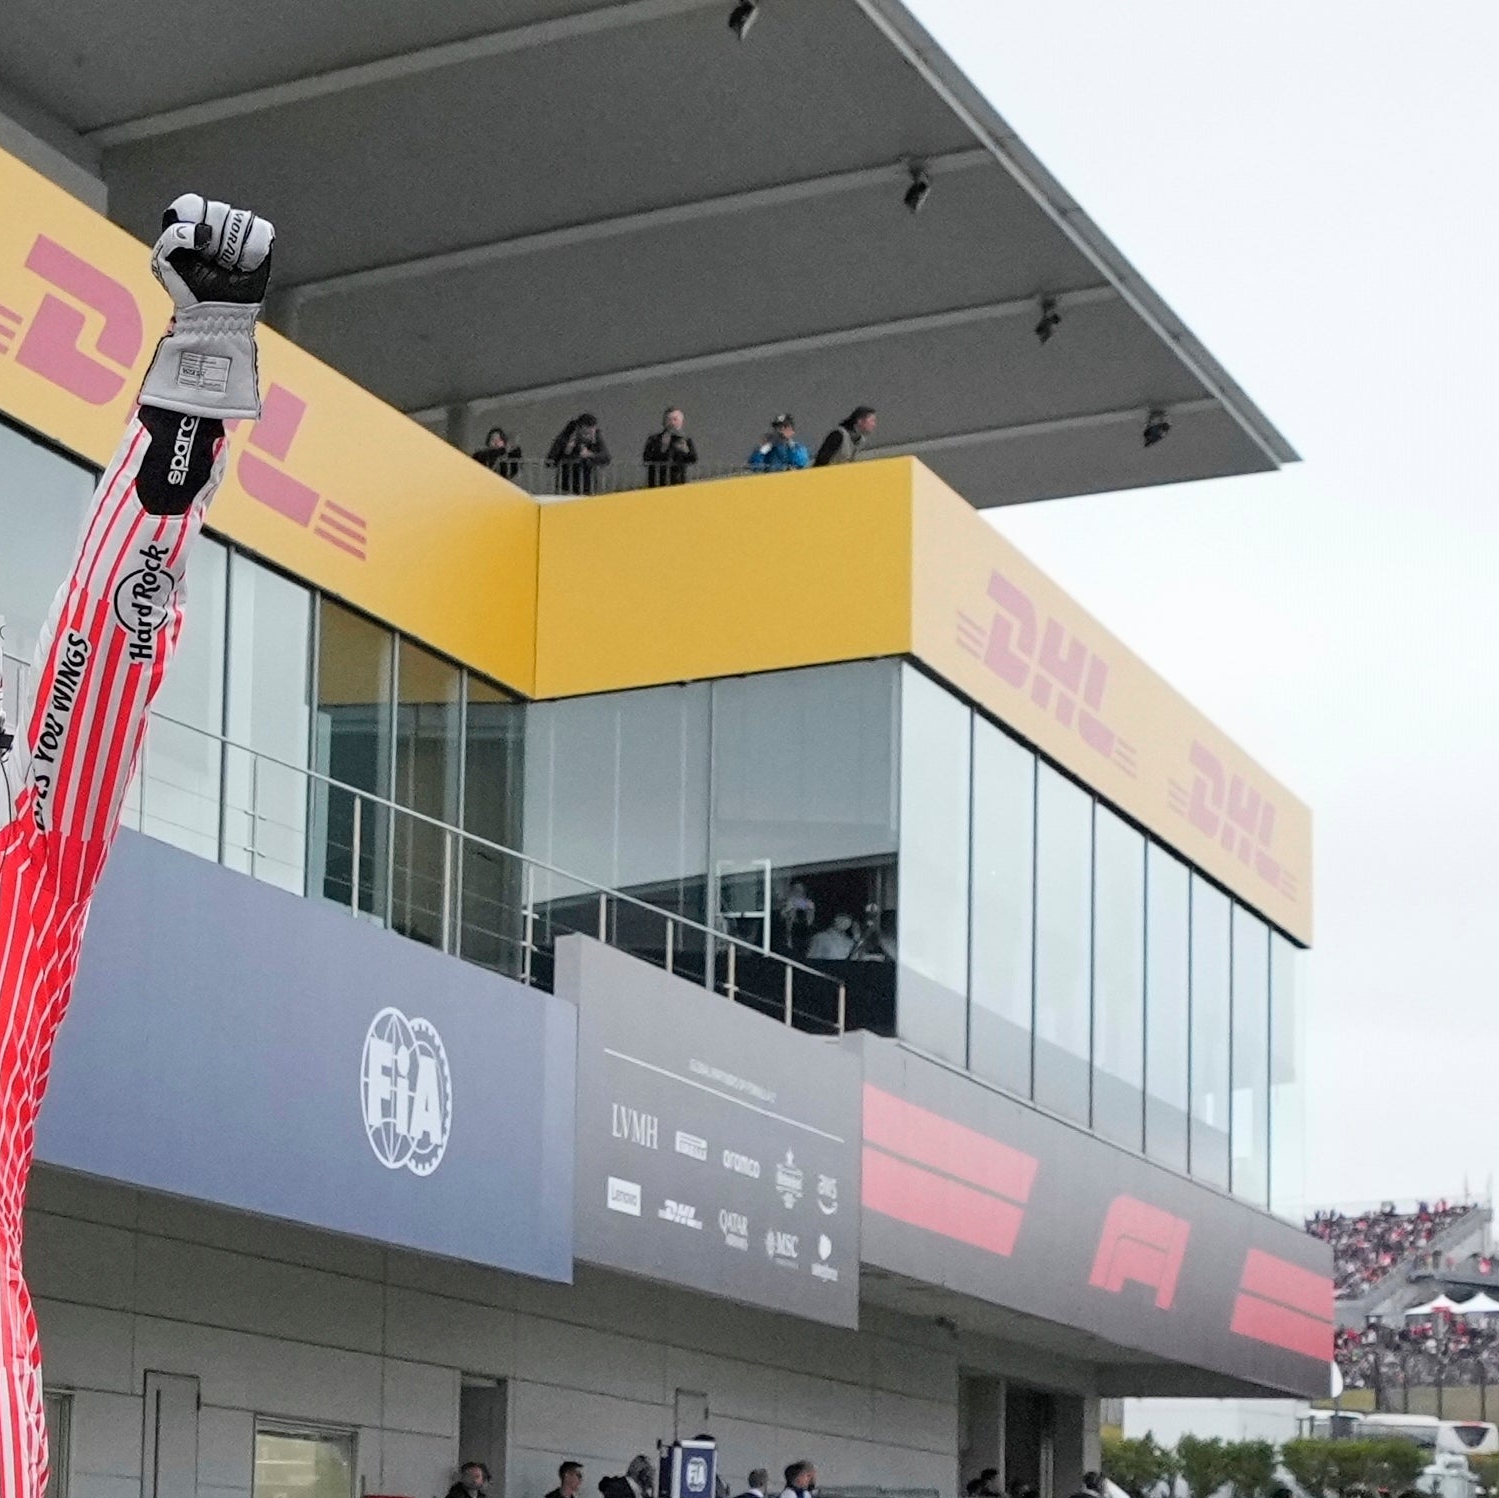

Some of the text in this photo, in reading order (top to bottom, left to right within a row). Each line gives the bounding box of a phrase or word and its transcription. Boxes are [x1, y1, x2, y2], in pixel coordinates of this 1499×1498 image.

[15, 233, 321, 528] DL
[167, 415, 201, 486] sparc
[129, 544, 170, 662] Hard Rock
[985, 569, 1116, 760] DHL
[34, 711, 65, 764] YOU
[52, 633, 89, 713] WINGS
[1189, 740, 1283, 887] DHL
[611, 1102, 659, 1150] LVMH
